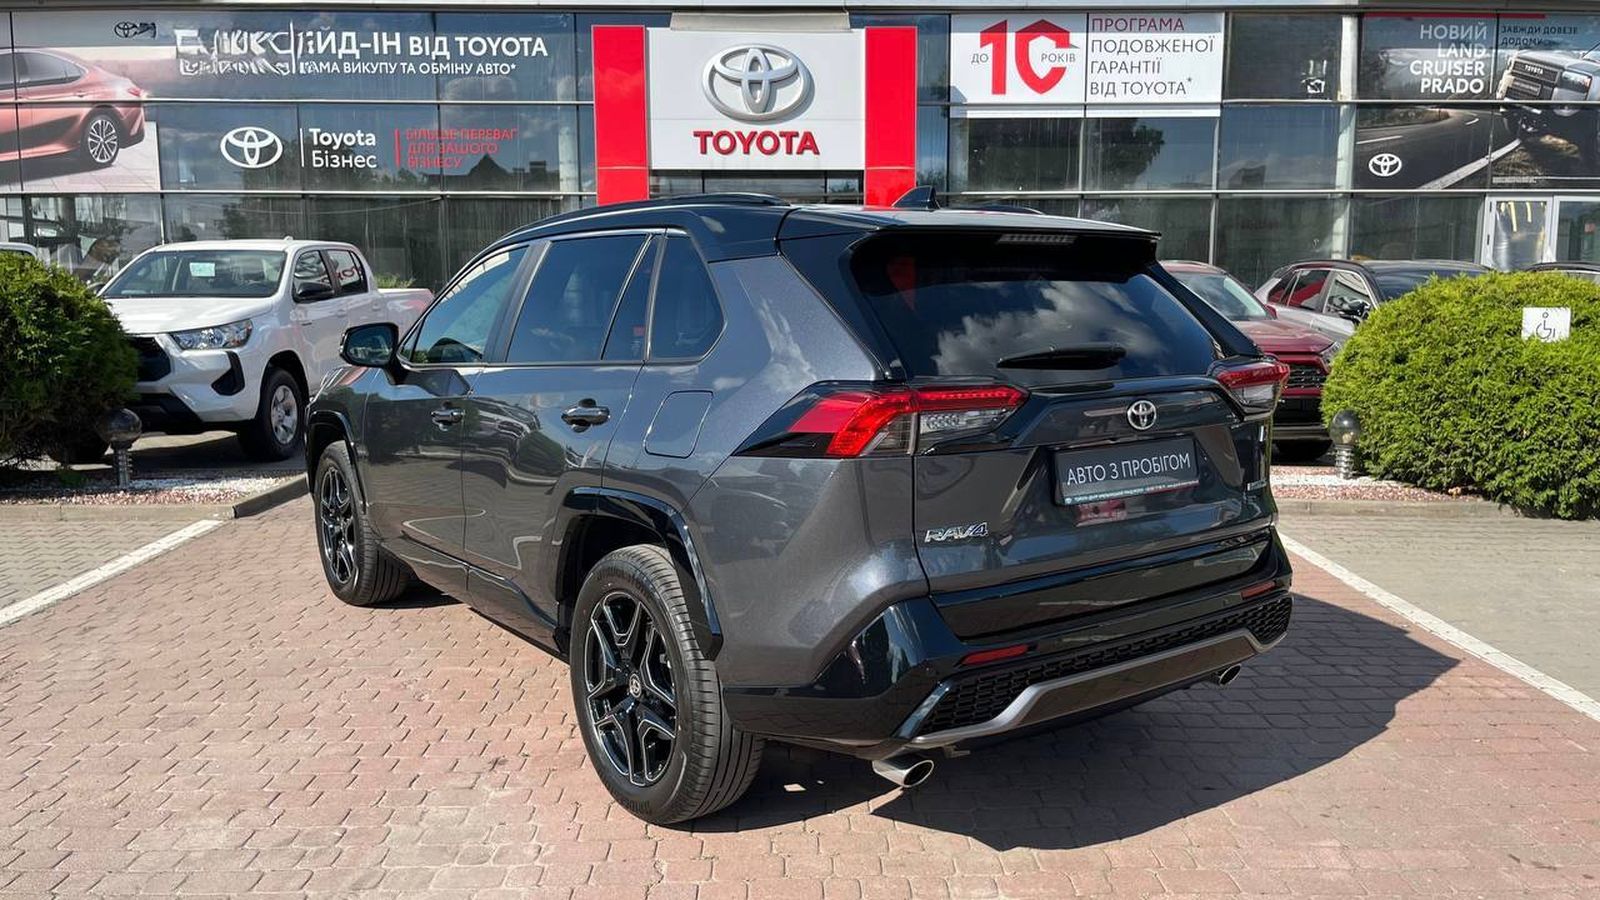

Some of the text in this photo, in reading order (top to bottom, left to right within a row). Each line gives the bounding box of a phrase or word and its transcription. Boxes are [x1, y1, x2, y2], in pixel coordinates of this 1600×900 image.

[1091, 18, 1185, 32] ПРОГРАМА
[1420, 22, 1487, 40] НОВИЙ
[409, 36, 450, 60] ВІД
[455, 36, 548, 57] TOYOTA
[1091, 35, 1216, 56] ПОДОВЖЕНОЇ
[1437, 43, 1487, 58] LAND
[971, 53, 989, 64] ДО
[1040, 52, 1076, 63] РОКІВ
[1090, 57, 1163, 75] ГАРАНТІЇ
[343, 61, 398, 75] ВИКУПУ
[400, 62, 416, 74] ТА
[419, 62, 473, 75] ОБМІНУ
[1409, 60, 1485, 76] CRUISER
[1090, 81, 1117, 98] ВІД
[1420, 78, 1485, 94] PRADO
[308, 127, 377, 150] Toyota
[692, 130, 821, 156] TOYOTA
[311, 150, 377, 169] Бізнес
[1066, 464, 1106, 486] АВТО
[1121, 452, 1192, 478] ПРОБІГОМ
[924, 521, 989, 543] RAV4
